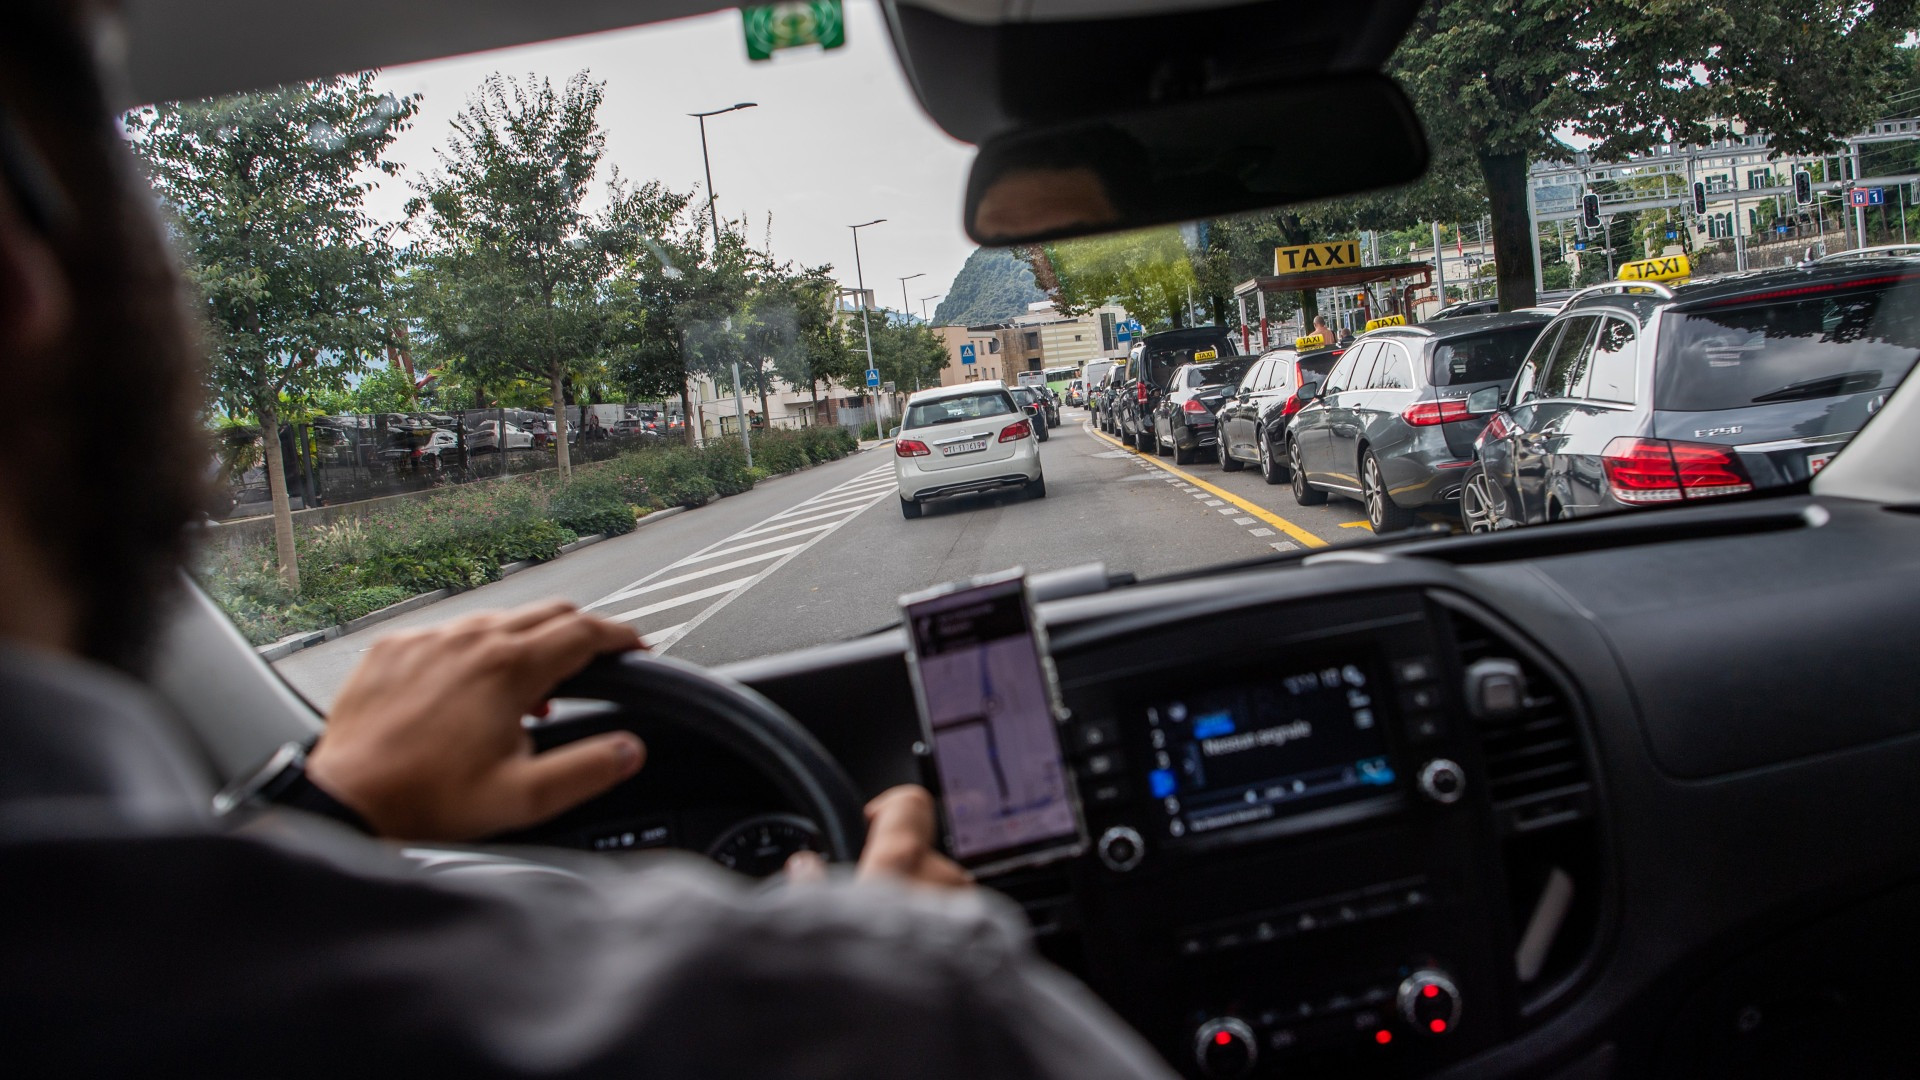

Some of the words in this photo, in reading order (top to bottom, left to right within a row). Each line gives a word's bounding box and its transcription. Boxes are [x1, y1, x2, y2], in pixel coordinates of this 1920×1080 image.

[1855, 194, 1863, 203] H
[1873, 192, 1878, 203] 1
[1283, 244, 1355, 269] TAXI
[1630, 257, 1680, 279] TAXI
[1374, 316, 1401, 329] TAXI
[1302, 336, 1320, 345] TAXI
[1198, 351, 1213, 359] TAXI
